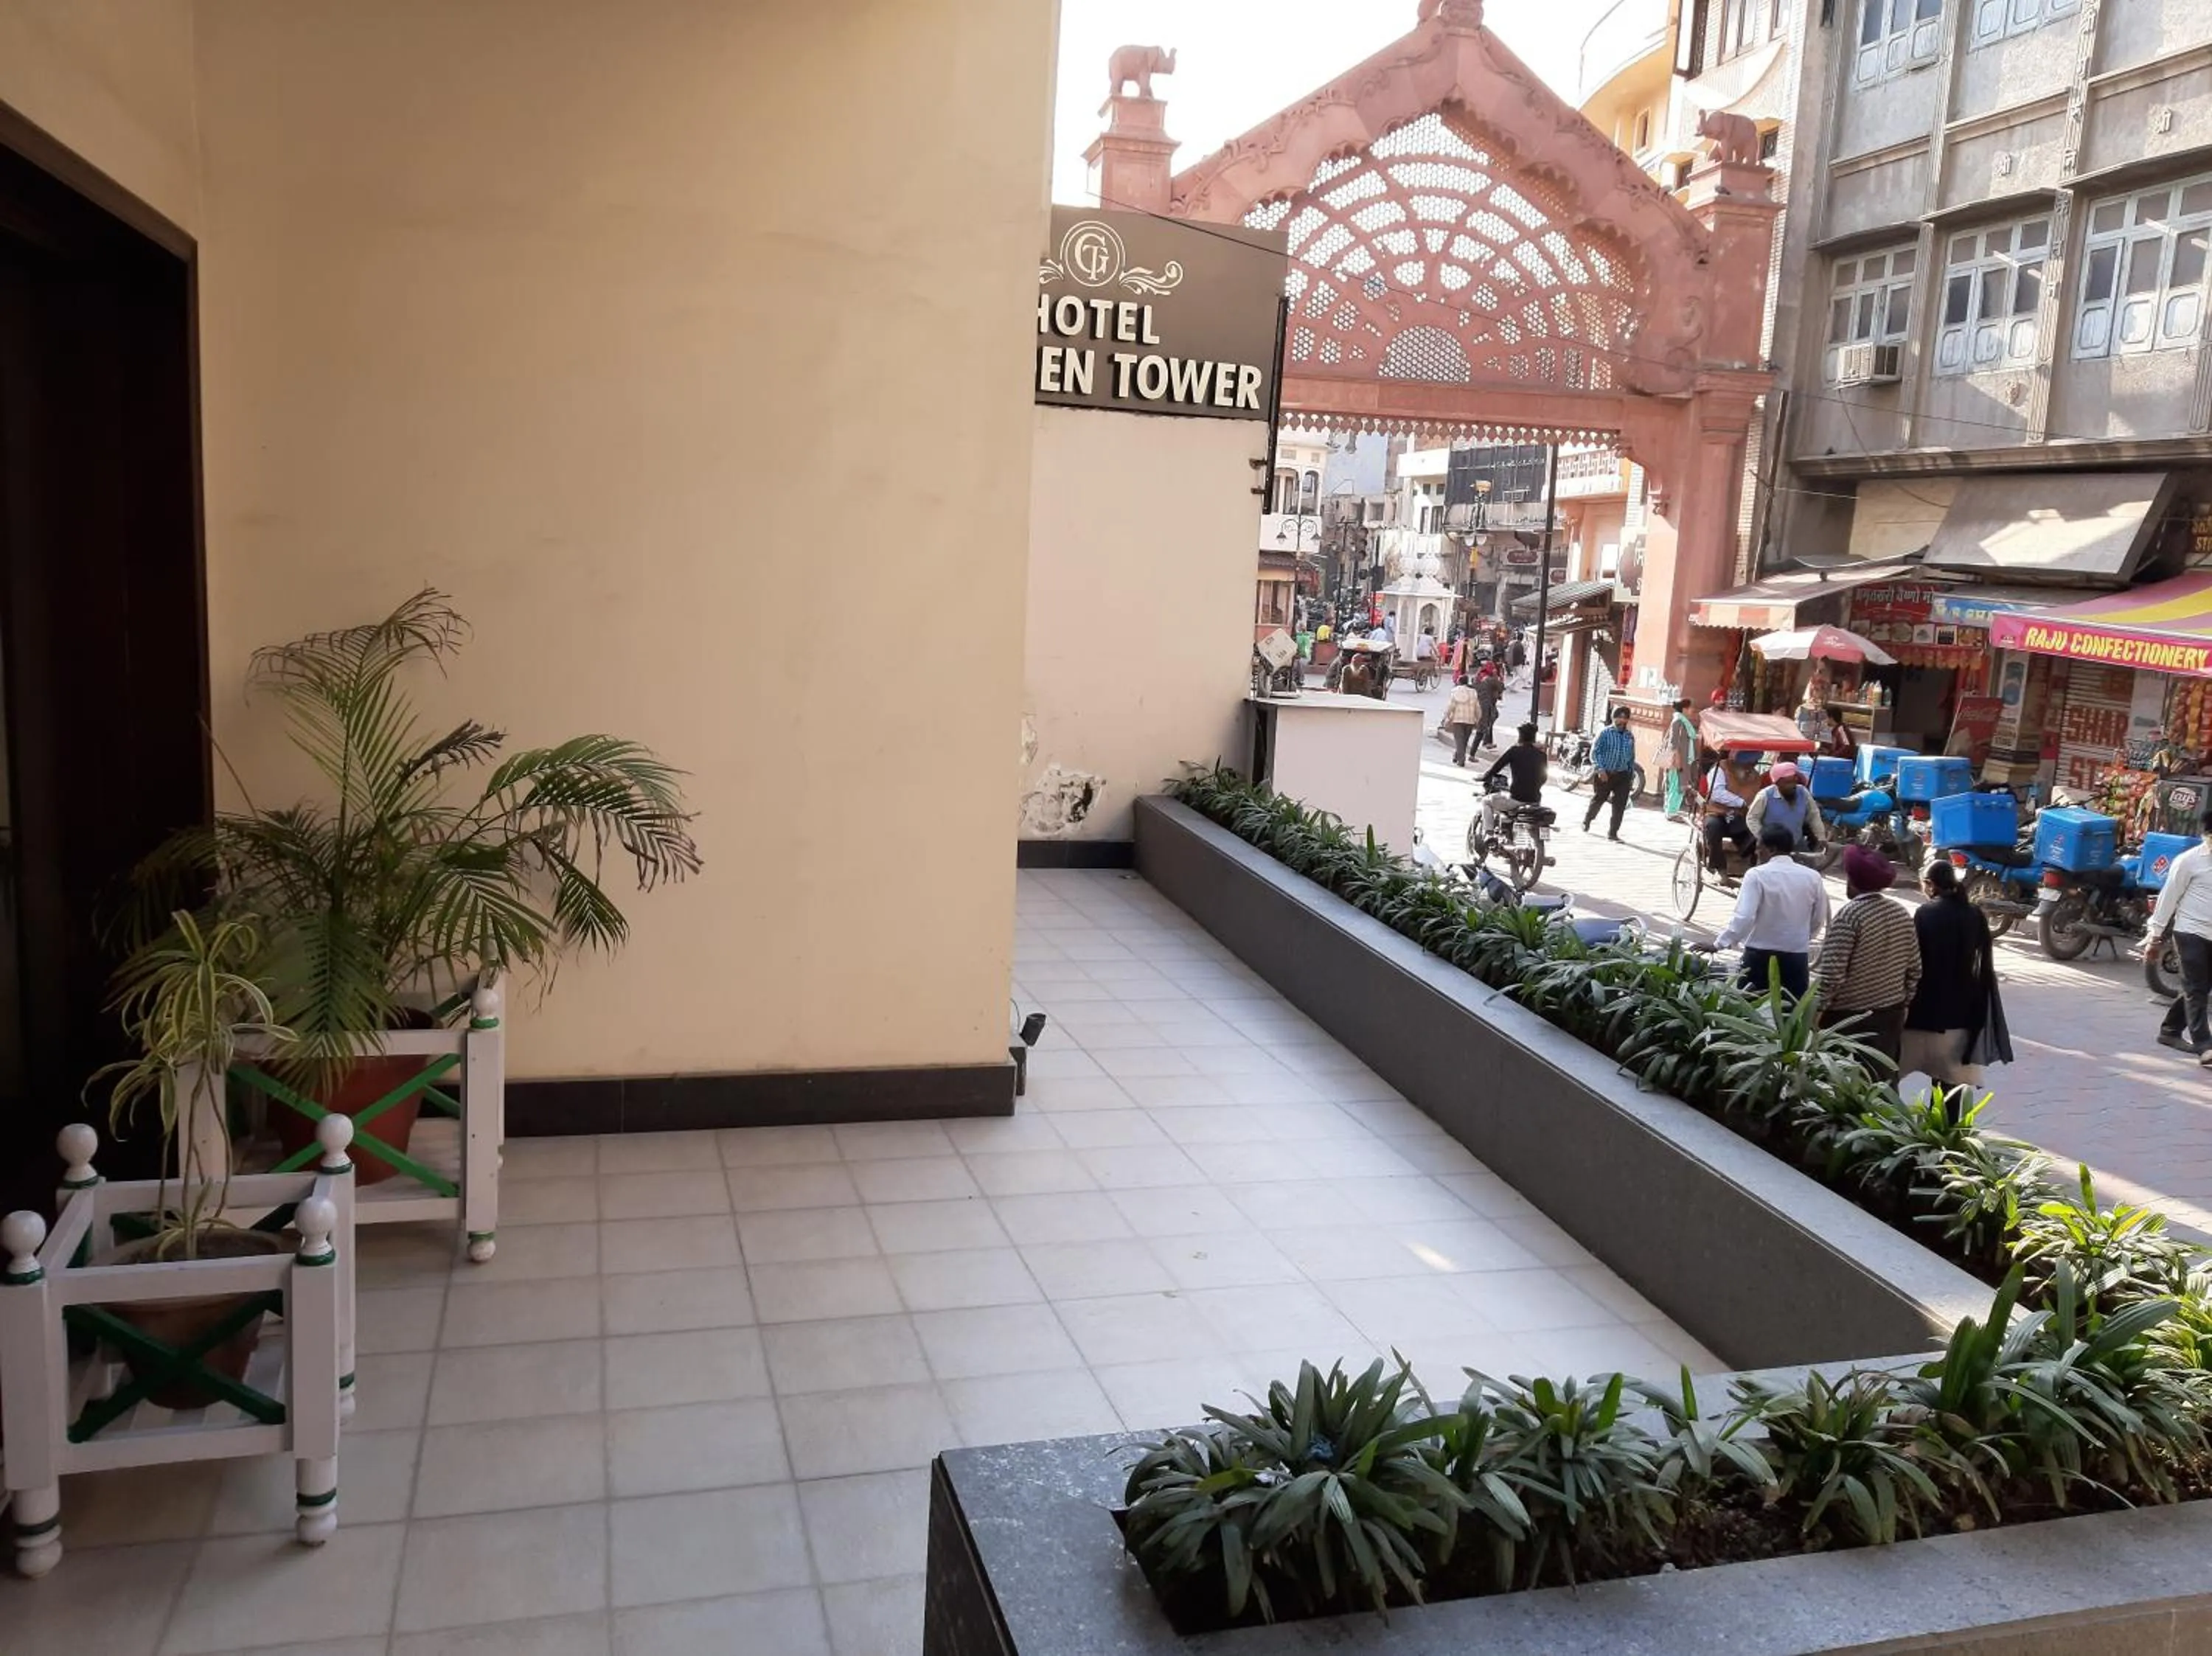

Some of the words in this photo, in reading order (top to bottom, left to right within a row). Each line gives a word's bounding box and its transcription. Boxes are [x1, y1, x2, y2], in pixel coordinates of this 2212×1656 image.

[1114, 352, 1262, 409] TOWER
[2025, 627, 2067, 650] RAJU
[2070, 633, 2209, 670] CONFECTIONERY
